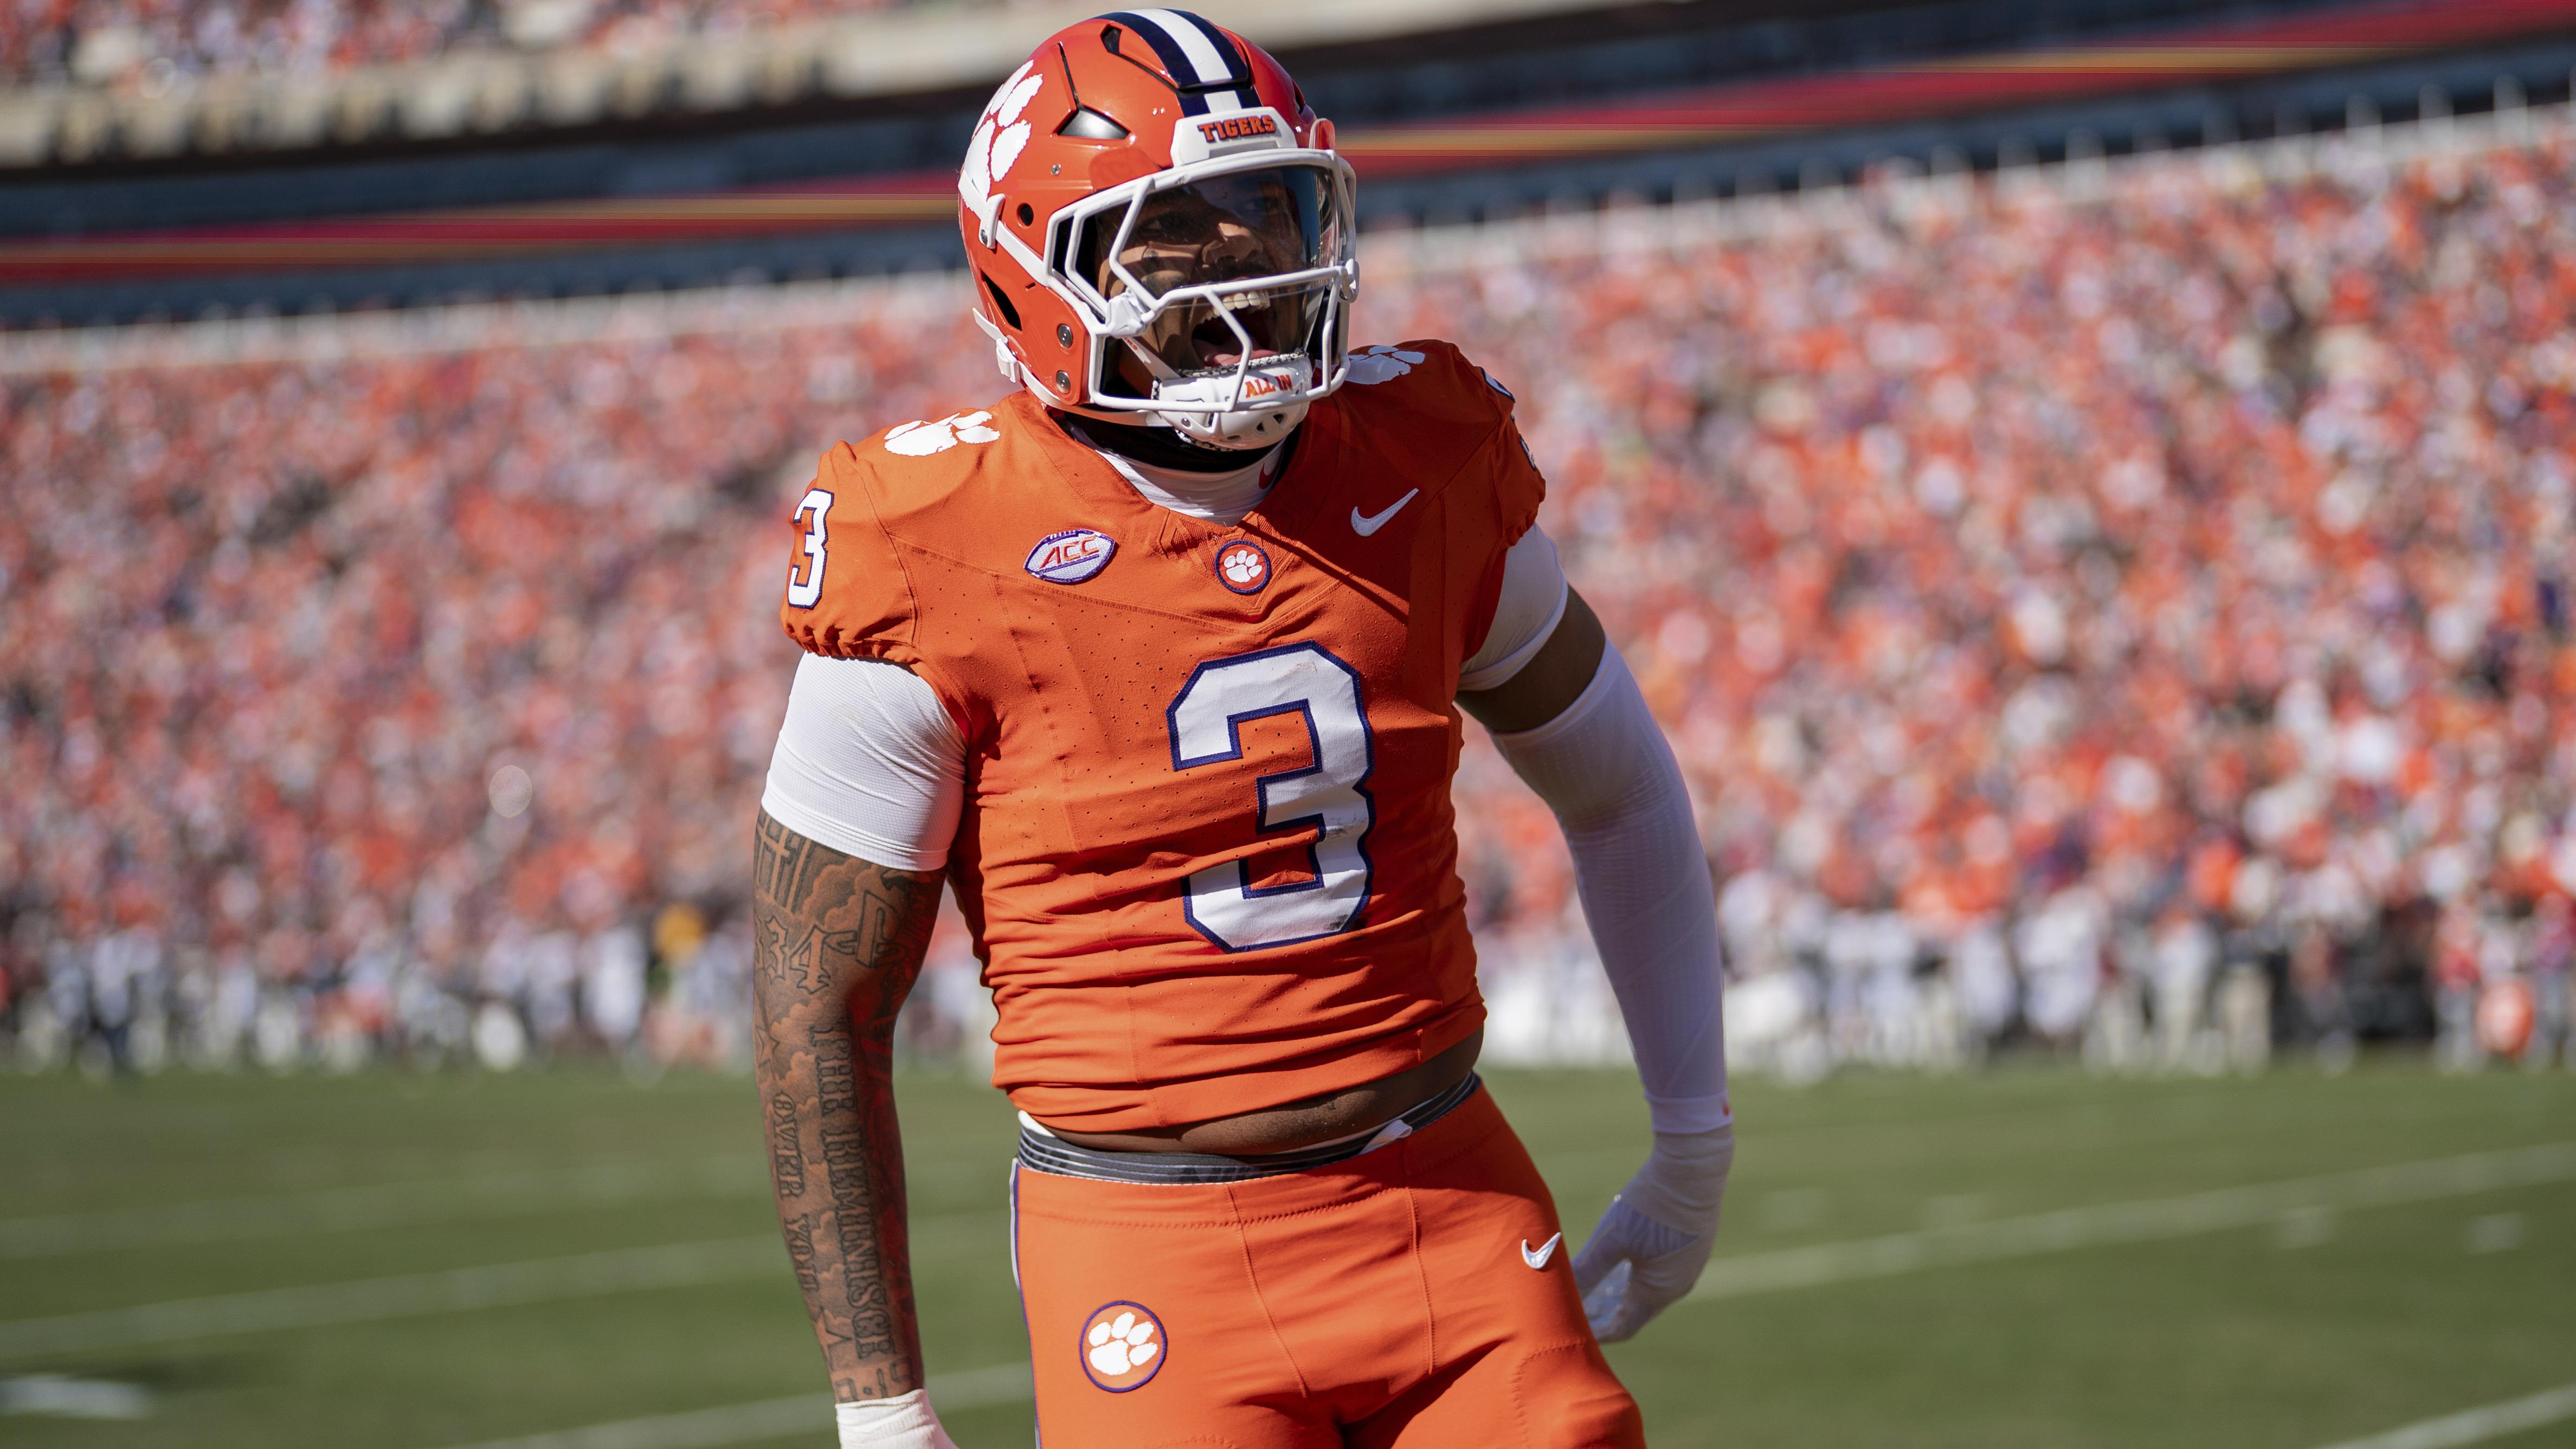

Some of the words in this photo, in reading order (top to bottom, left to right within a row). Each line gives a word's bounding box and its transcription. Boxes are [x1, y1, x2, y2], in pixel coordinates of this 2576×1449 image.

[1197, 114, 1276, 143] TIGERS
[1245, 378, 1276, 398] ALL
[1275, 374, 1293, 390] IN
[788, 488, 835, 610] 3
[1038, 534, 1099, 569] ACC
[1167, 640, 1376, 954] 3
[809, 1026, 859, 1117] THE
[772, 1090, 806, 1200] OVER
[784, 1213, 819, 1292] YOU
[820, 1128, 896, 1360] REMINISCE
